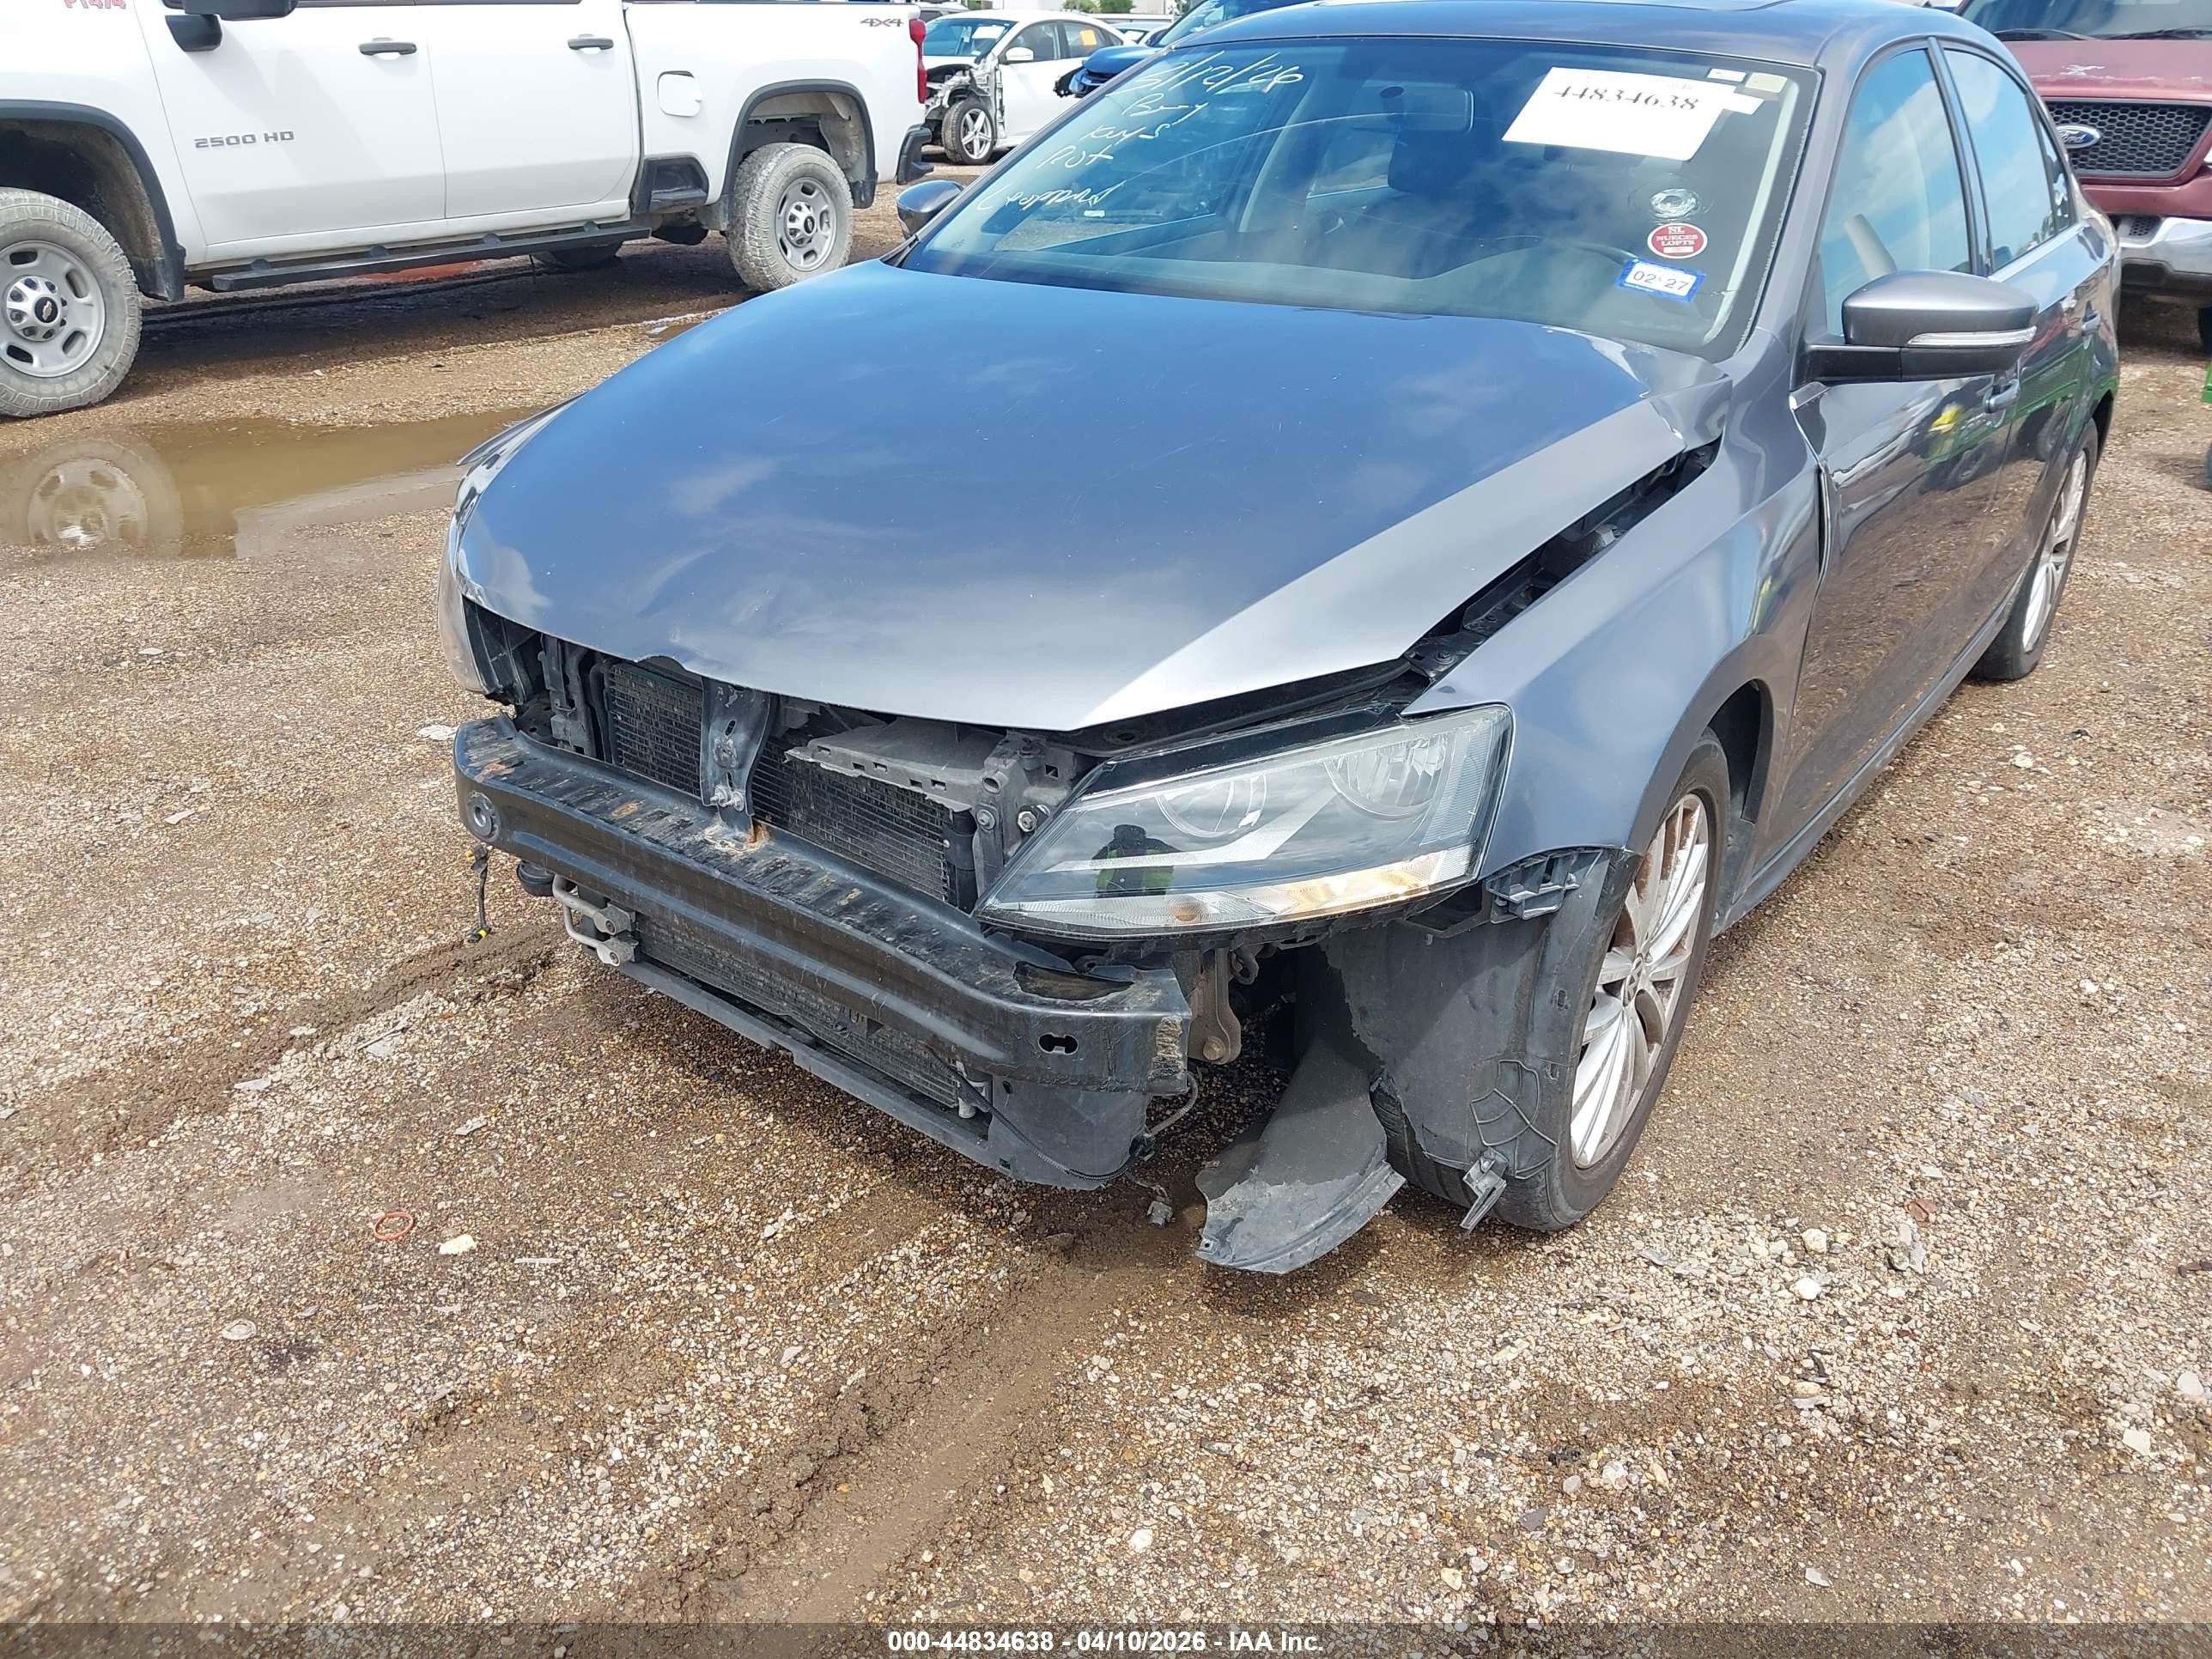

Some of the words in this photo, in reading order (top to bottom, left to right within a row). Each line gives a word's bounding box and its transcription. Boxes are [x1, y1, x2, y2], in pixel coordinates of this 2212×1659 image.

[1554, 85, 1699, 111] 44834638
[194, 134, 256, 149] 2500
[264, 131, 295, 143] HD
